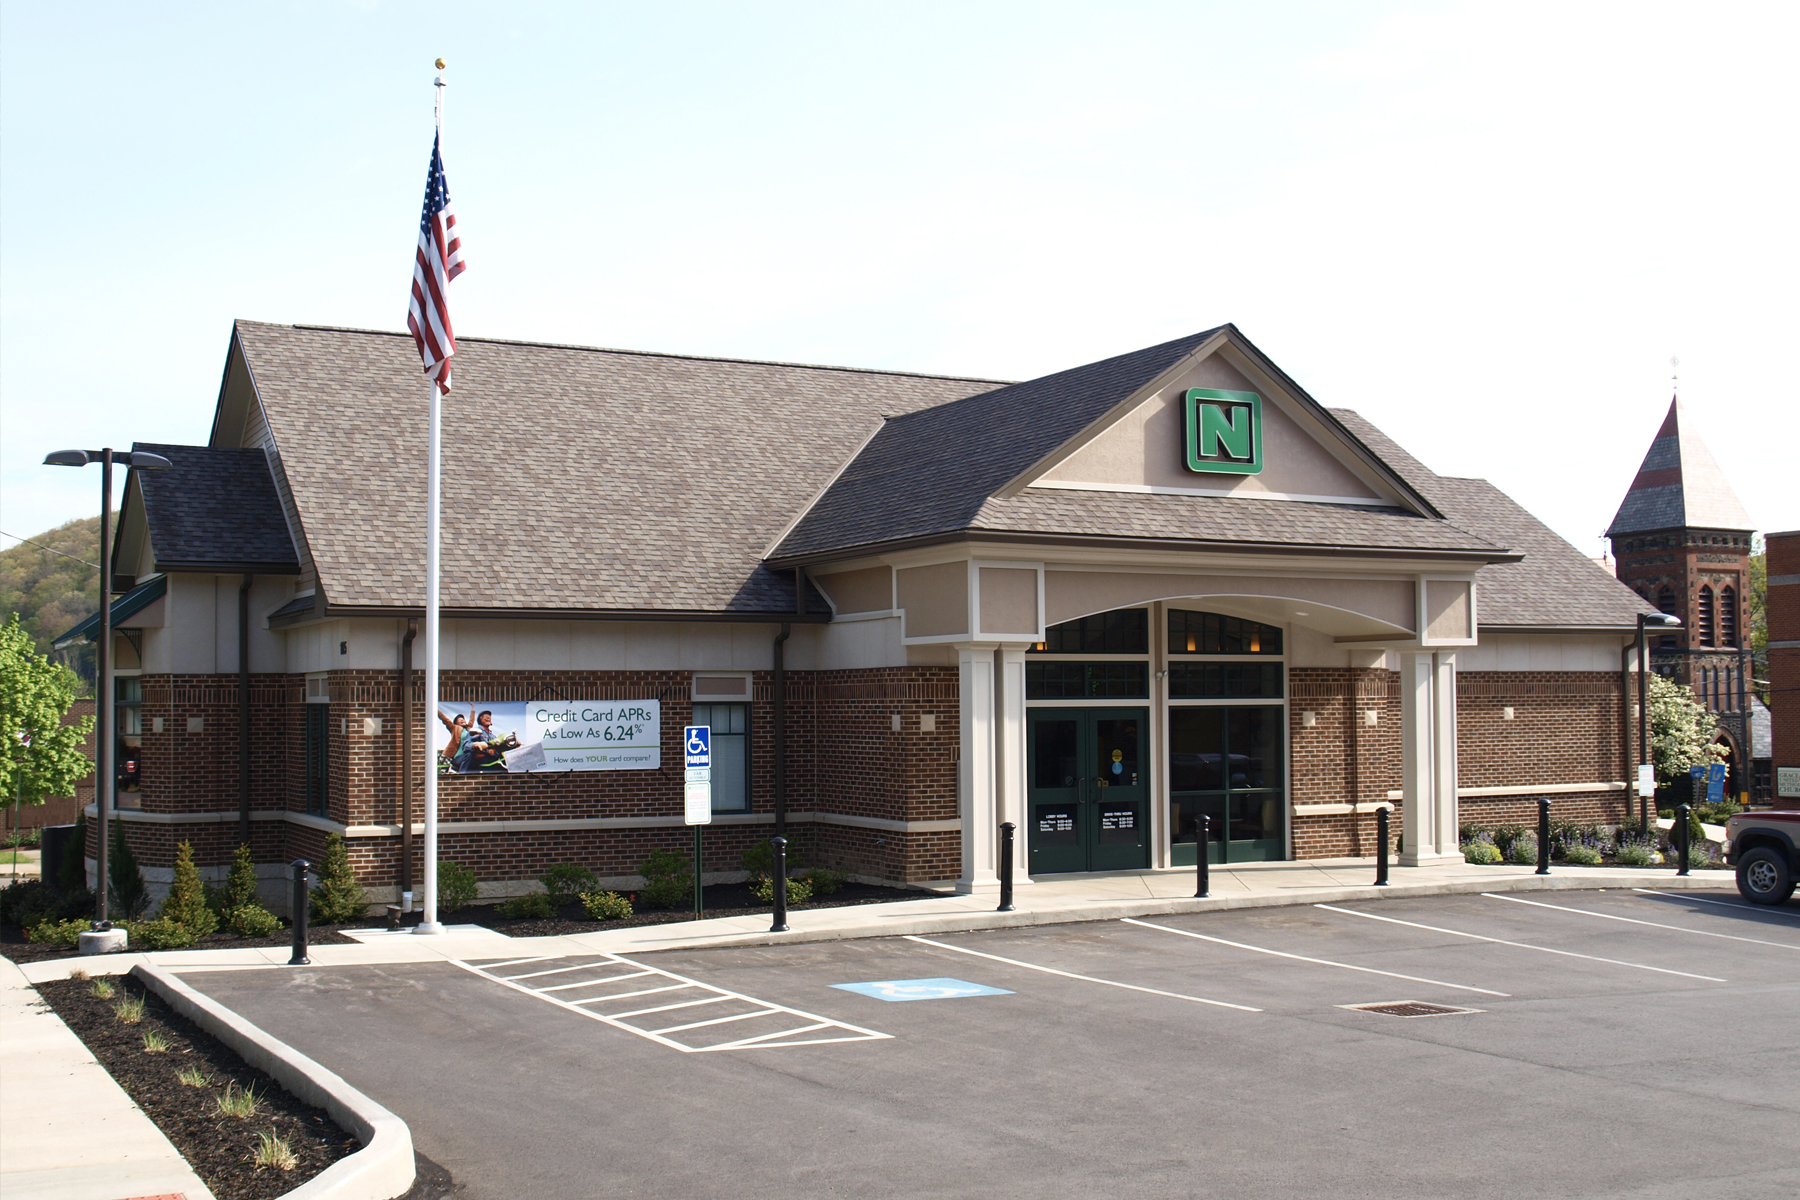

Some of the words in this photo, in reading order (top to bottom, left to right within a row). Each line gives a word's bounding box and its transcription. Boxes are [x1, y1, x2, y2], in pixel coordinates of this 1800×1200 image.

[1200, 404, 1250, 459] N
[536, 709, 577, 722] Credit
[581, 708, 613, 722] Card
[617, 708, 652, 721] APRs
[543, 728, 557, 739] As
[561, 728, 583, 739] Low
[586, 727, 600, 738] As
[687, 755, 709, 764] PARKING
